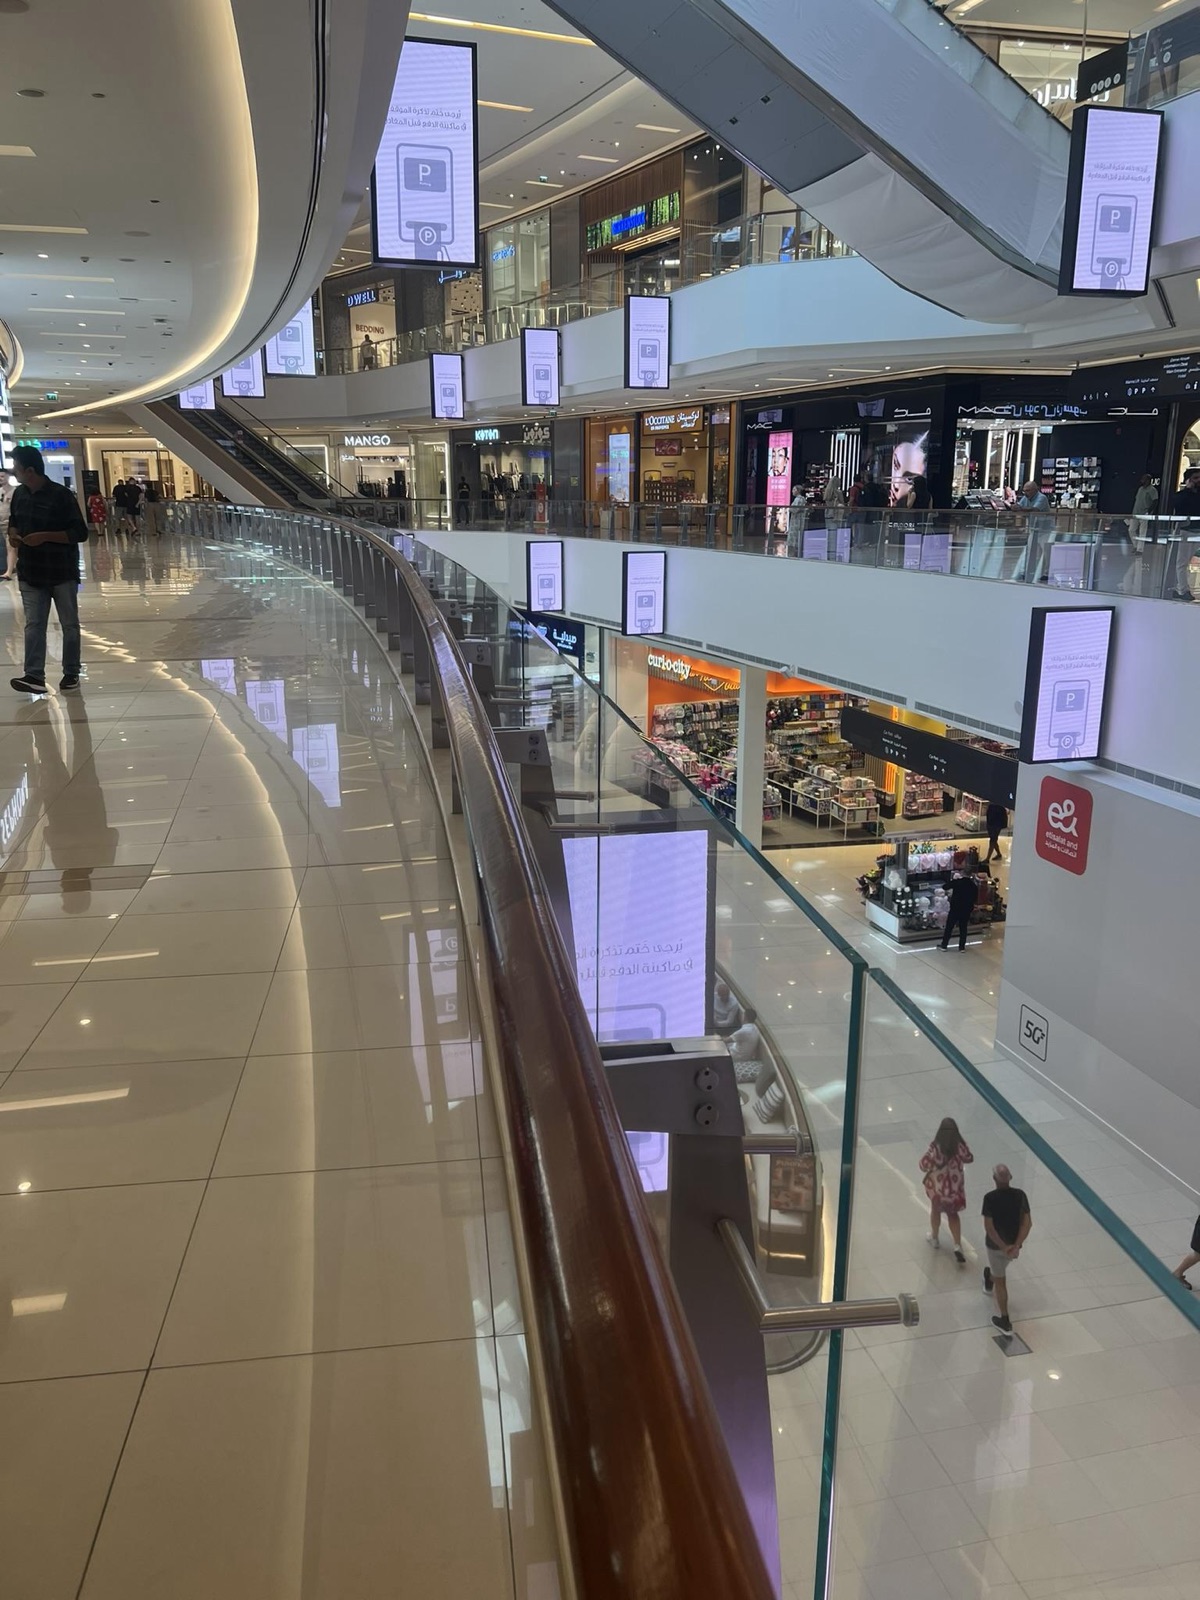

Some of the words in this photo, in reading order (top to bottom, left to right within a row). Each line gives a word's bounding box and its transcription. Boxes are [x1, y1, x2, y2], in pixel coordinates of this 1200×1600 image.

[347, 290, 376, 306] DWELL
[356, 324, 385, 334] BEDDING
[344, 434, 390, 446] MANGO
[1045, 831, 1066, 846] etisalat
[1066, 840, 1078, 850] and
[590, 944, 622, 960] تذكرة
[608, 964, 640, 978] الدفع
[642, 961, 681, 974] ماكينة
[684, 958, 694, 972] في
[1024, 1020, 1046, 1045] 5G
